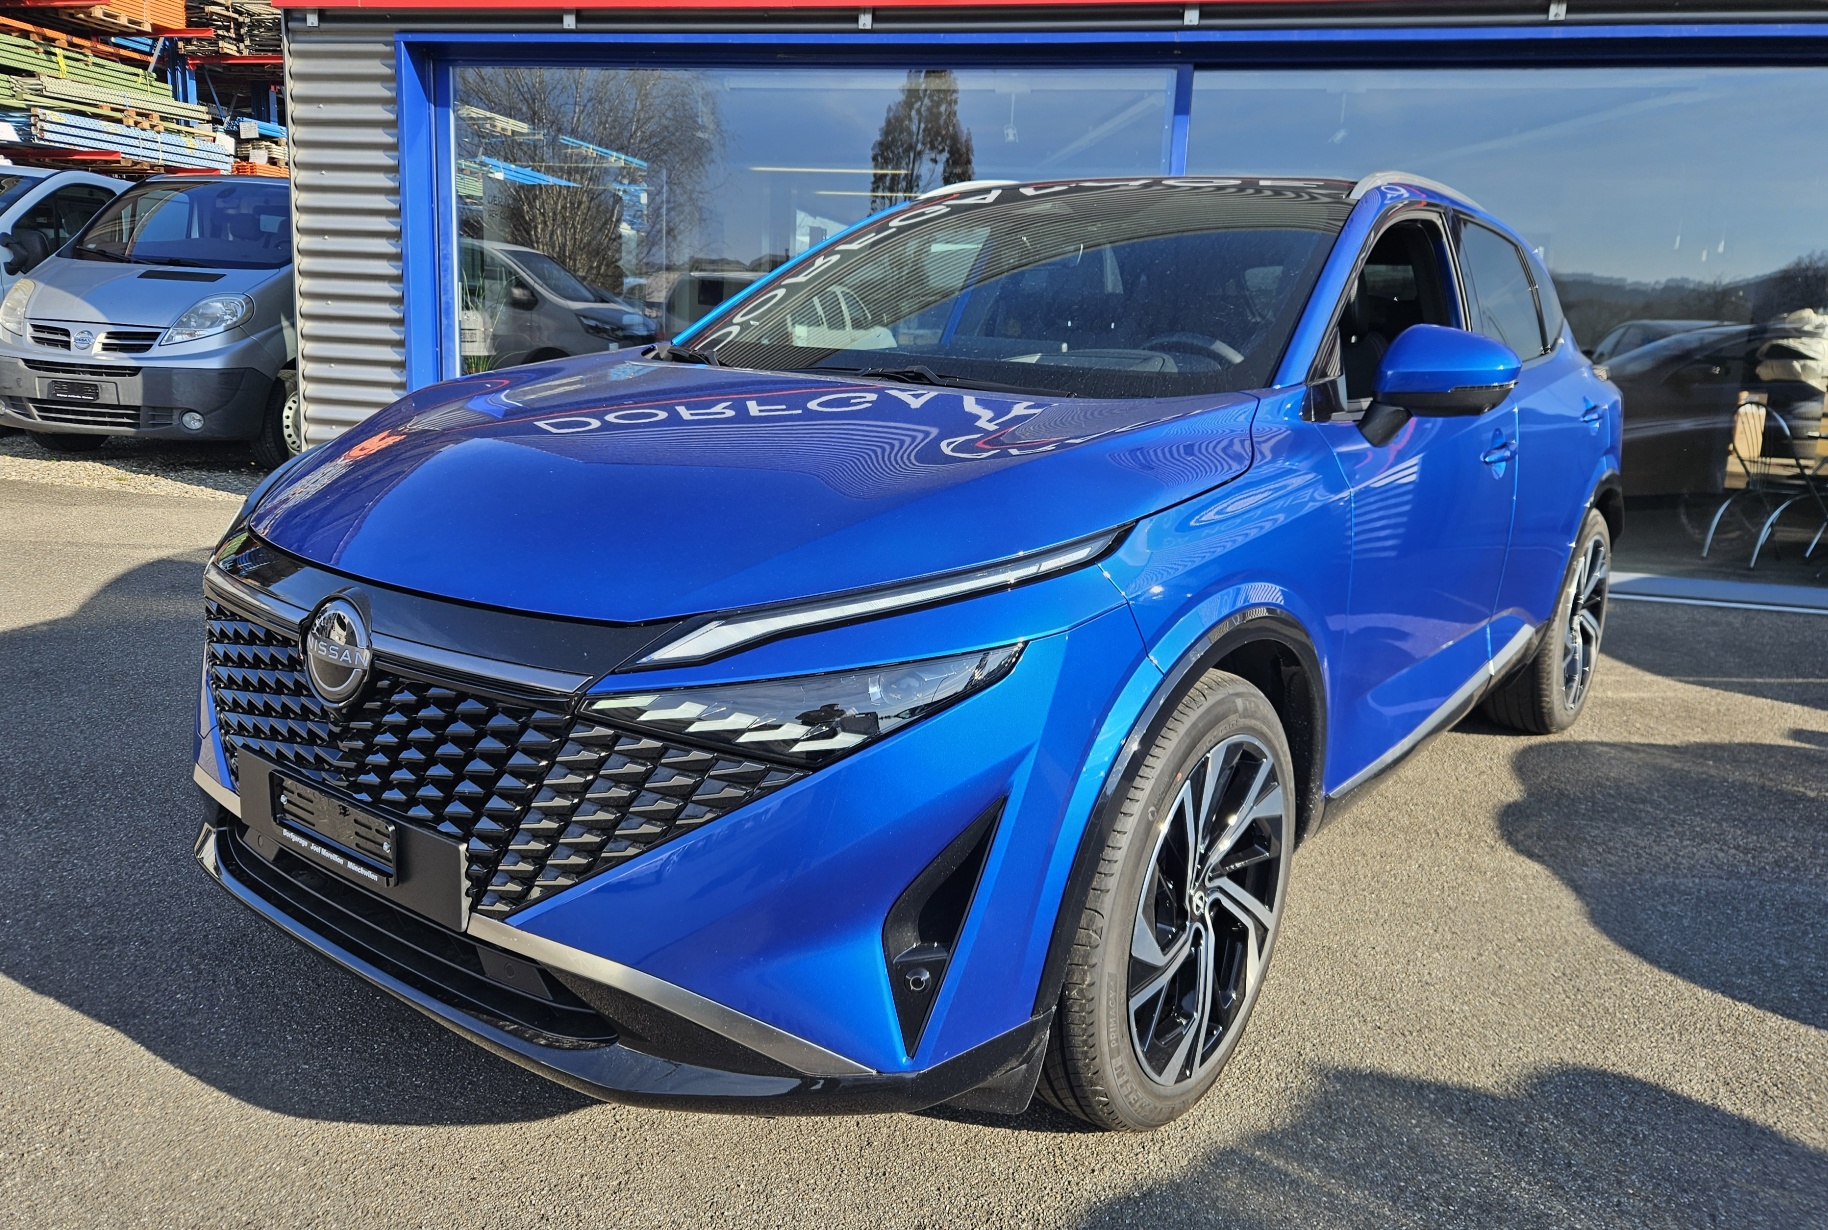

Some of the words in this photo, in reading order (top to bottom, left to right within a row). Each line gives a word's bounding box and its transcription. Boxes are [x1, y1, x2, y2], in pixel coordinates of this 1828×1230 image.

[307, 634, 369, 667] NISSAN
[282, 828, 308, 847] Dorfgarage
[1108, 990, 1119, 1048] PRIMACY
